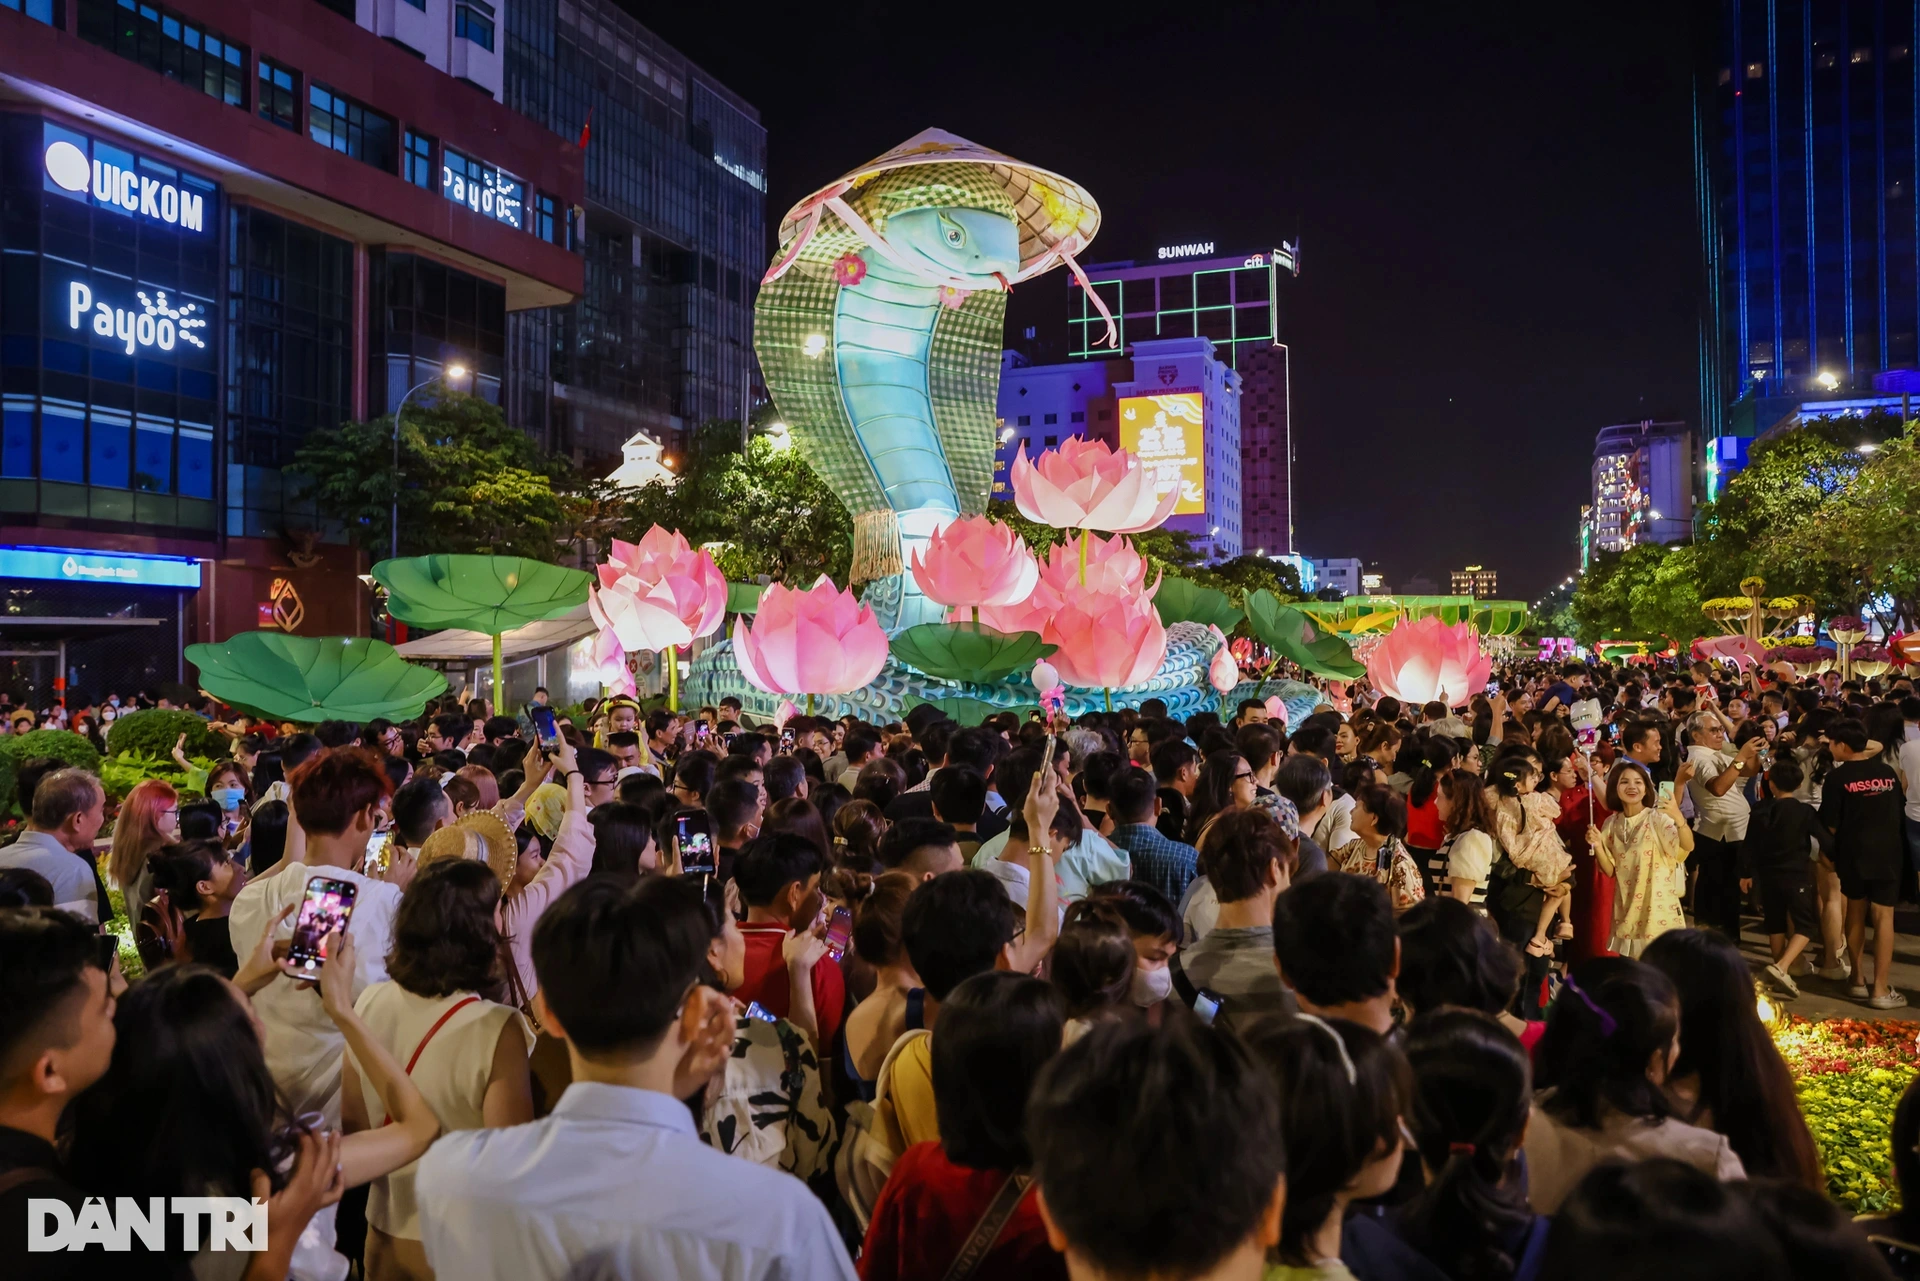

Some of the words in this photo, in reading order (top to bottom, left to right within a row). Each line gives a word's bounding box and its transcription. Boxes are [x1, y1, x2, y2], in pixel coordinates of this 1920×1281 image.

[45, 141, 203, 232] QUICKOM
[1158, 241, 1214, 259] SUNWAH
[70, 281, 176, 355] Payoo
